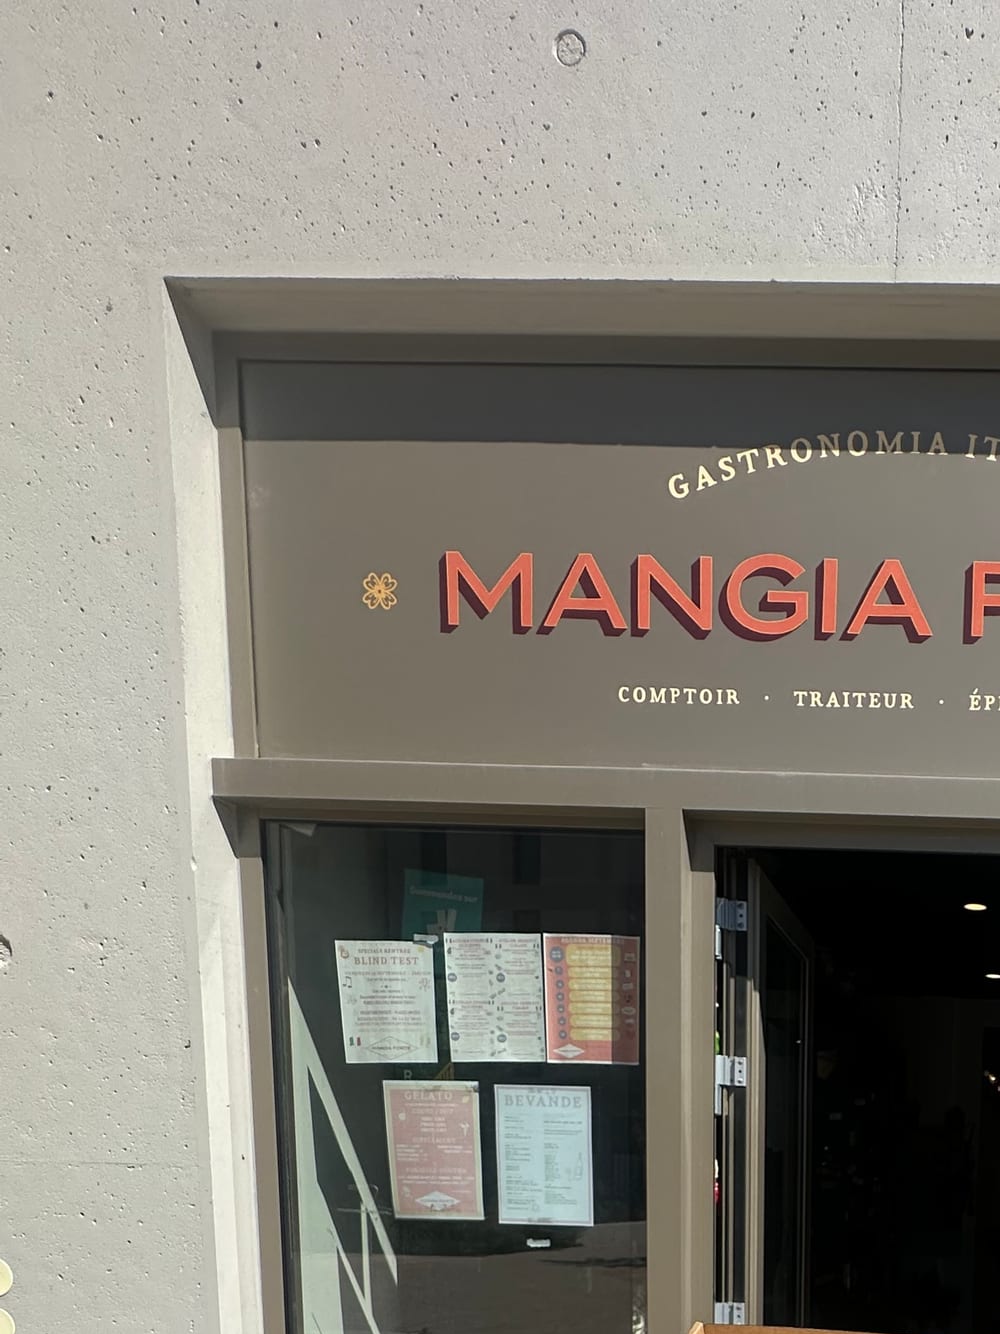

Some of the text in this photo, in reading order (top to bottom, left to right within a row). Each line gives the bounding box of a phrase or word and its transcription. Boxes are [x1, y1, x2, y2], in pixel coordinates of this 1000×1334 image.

[667, 430, 948, 499] GASTRONOMIA
[438, 551, 933, 643] MANGIA
[618, 687, 740, 705] COMPTOIR
[794, 690, 914, 709] TRAITEUR
[354, 957, 419, 966] BLIND TEST
[404, 1091, 453, 1101] GELATO
[504, 1094, 582, 1109] BEVANDE
